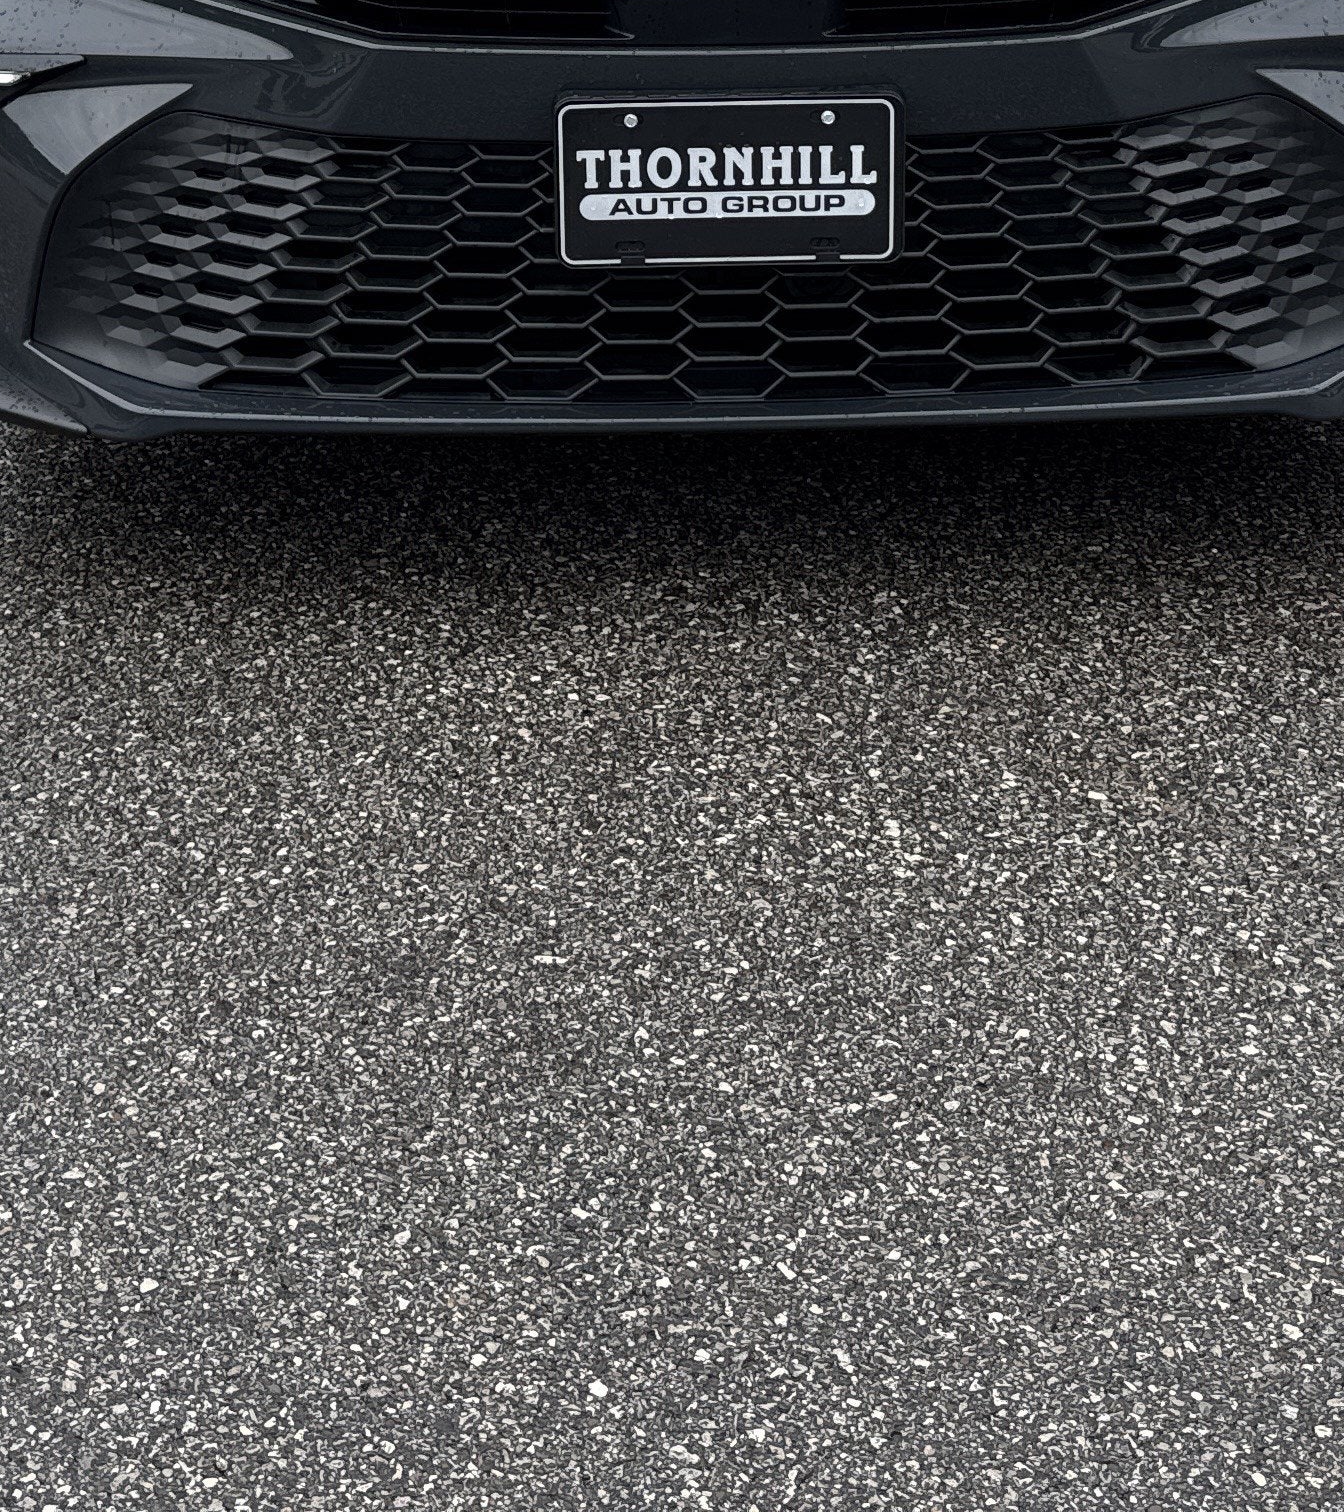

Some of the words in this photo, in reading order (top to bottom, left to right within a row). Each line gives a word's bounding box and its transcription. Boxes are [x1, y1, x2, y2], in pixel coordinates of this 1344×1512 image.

[575, 144, 878, 189] THORNHILL
[608, 196, 708, 217] AUTO
[721, 194, 846, 214] GROUP
